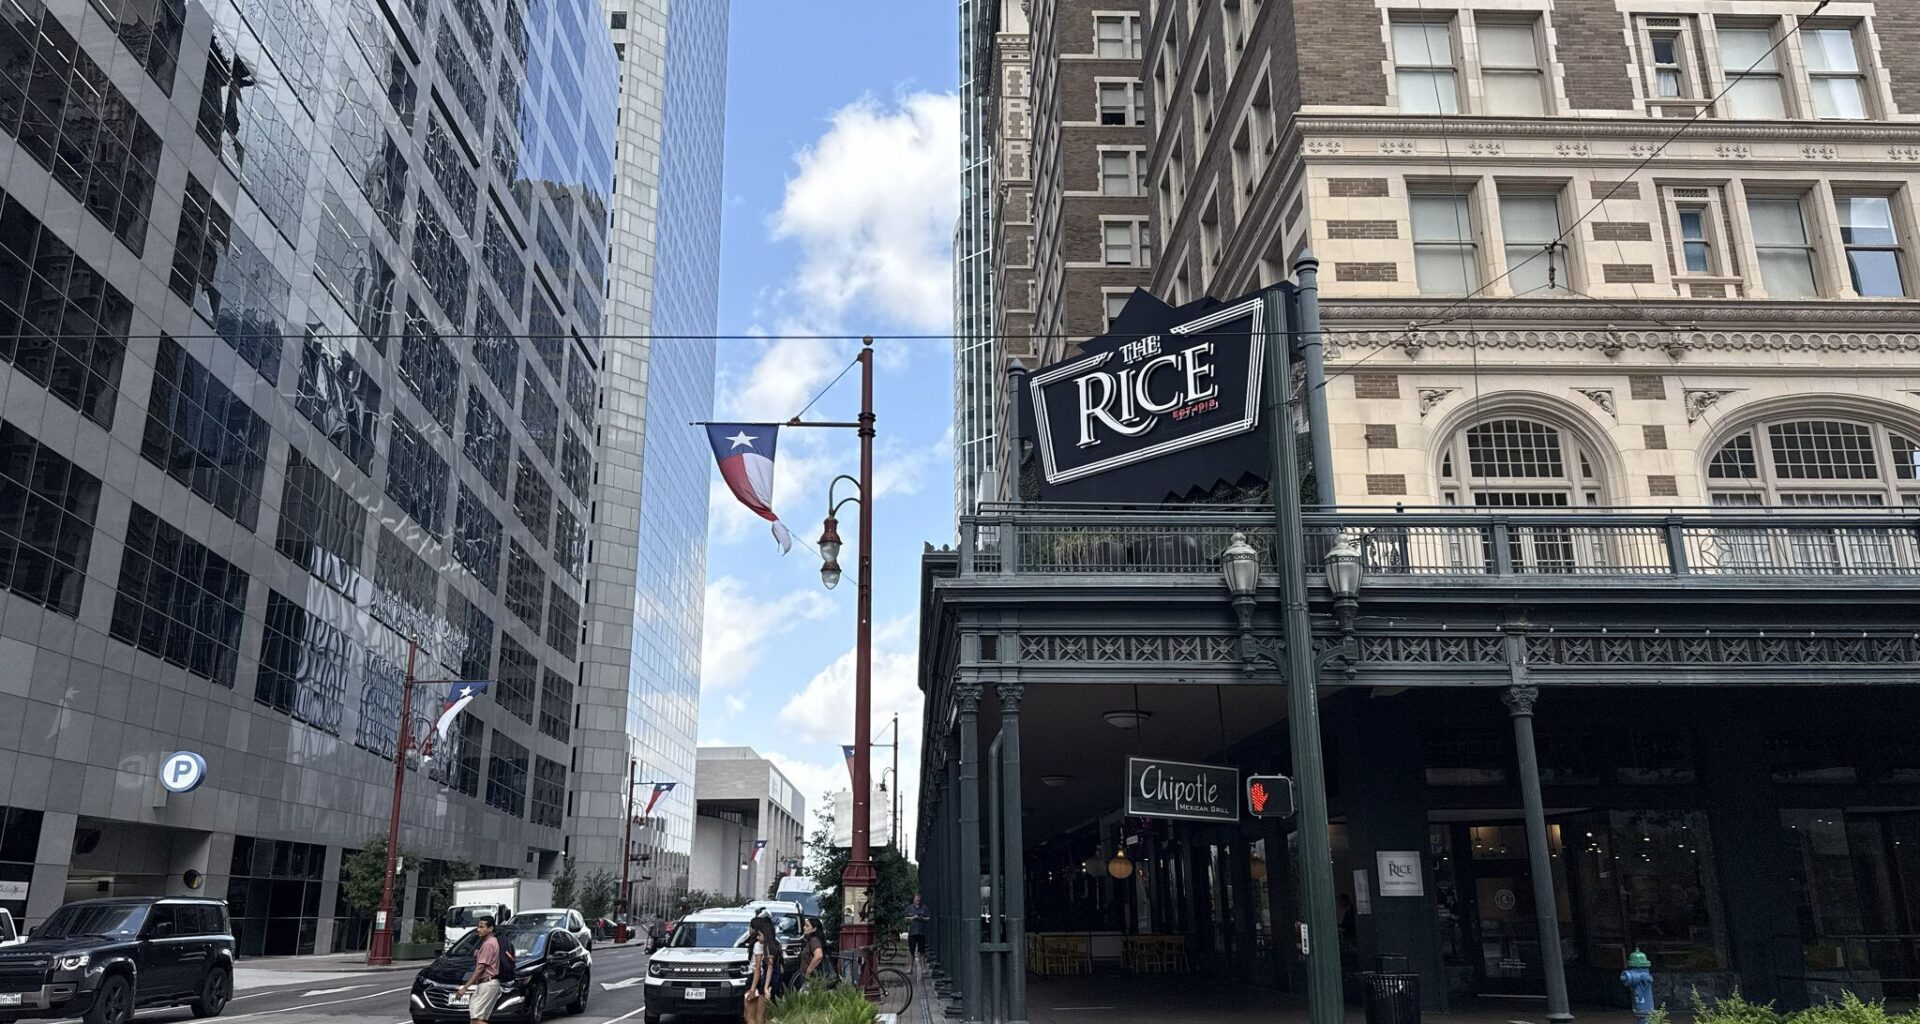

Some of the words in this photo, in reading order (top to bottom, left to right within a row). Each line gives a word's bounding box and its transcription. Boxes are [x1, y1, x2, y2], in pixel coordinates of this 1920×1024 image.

[1119, 336, 1161, 364] THE
[1073, 342, 1218, 449] RICE
[172, 760, 192, 783] P
[1140, 765, 1218, 811] Chipotle
[1180, 803, 1208, 812] MEXICAN
[1210, 805, 1230, 814] GRILL
[1389, 863, 1412, 877] RICE
